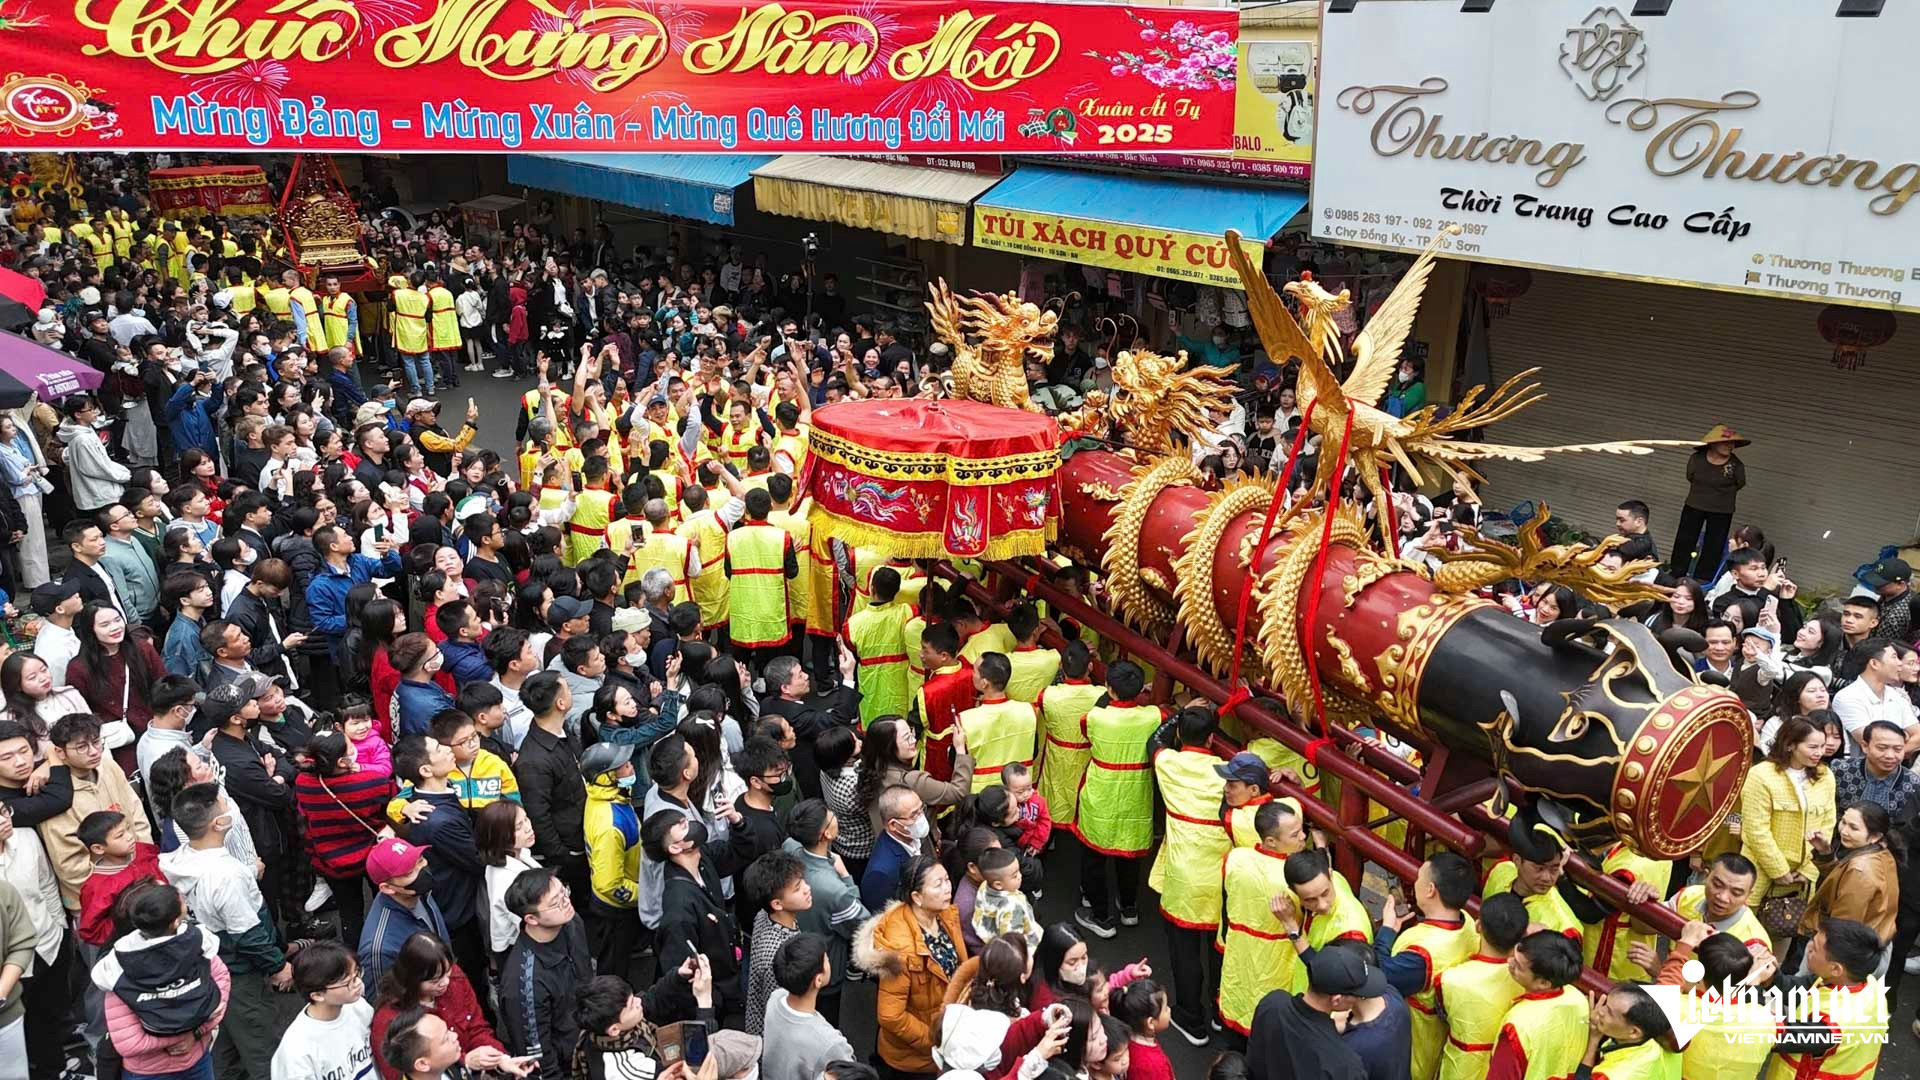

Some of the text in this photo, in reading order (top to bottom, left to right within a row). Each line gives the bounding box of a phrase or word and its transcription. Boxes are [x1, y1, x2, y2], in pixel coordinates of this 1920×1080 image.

[74, 0, 1061, 92] Chúc Mừng Năm Mới
[150, 91, 269, 145] Mừng
[281, 95, 381, 146] Đảng
[422, 97, 522, 147] Mừng
[529, 101, 614, 140] Xuân
[651, 102, 737, 149] Mừng
[749, 105, 802, 141] Quê
[812, 108, 901, 149] Hương
[908, 100, 951, 142] Đổi
[959, 107, 1005, 142] Mới
[1078, 97, 1135, 117] Xuân
[1098, 123, 1173, 144] 2025
[1336, 77, 1920, 216] Thương Thương
[1289, 166, 1304, 175] 737
[1335, 209, 1359, 221] 0985
[1362, 212, 1381, 224] 263
[1384, 214, 1402, 226] 197
[1412, 217, 1433, 230] 092
[1462, 223, 1488, 236] 1997
[1440, 187, 1752, 242] Thời Trang Cao Cấp
[982, 211, 1025, 238] TÚI
[1031, 219, 1107, 251] XÁCH
[1114, 232, 1177, 261] QUÝ
[1335, 226, 1358, 239] Chợ
[1359, 228, 1388, 242] Đồng
[1455, 240, 1480, 253] Sơn
[1769, 254, 1833, 275] Thương
[1838, 260, 1905, 282] Thương
[1766, 273, 1902, 303] Thương Thương
